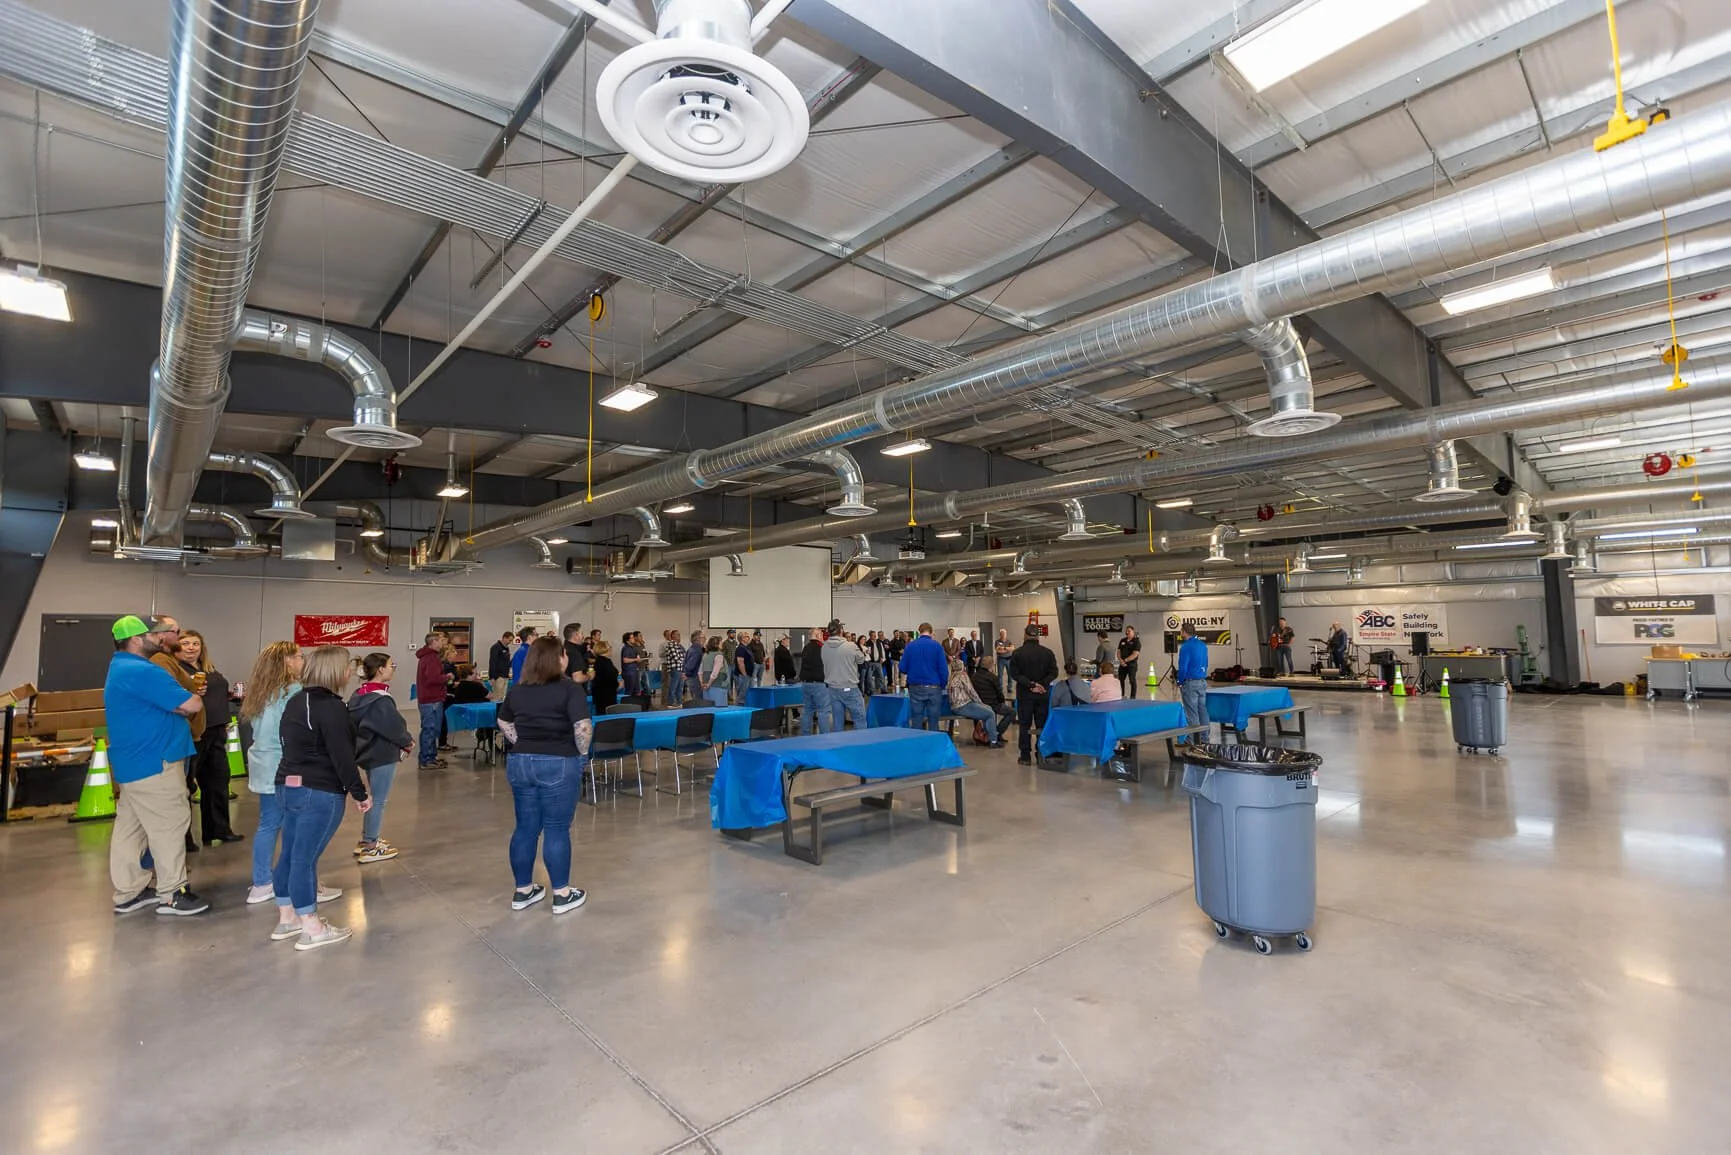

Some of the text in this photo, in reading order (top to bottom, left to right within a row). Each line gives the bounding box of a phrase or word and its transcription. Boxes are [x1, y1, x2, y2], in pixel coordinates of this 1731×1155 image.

[1627, 600, 1667, 608] WHITE
[320, 619, 369, 634] Milwaukee
[1360, 615, 1396, 628] ABC
[1403, 622, 1438, 630] Building
